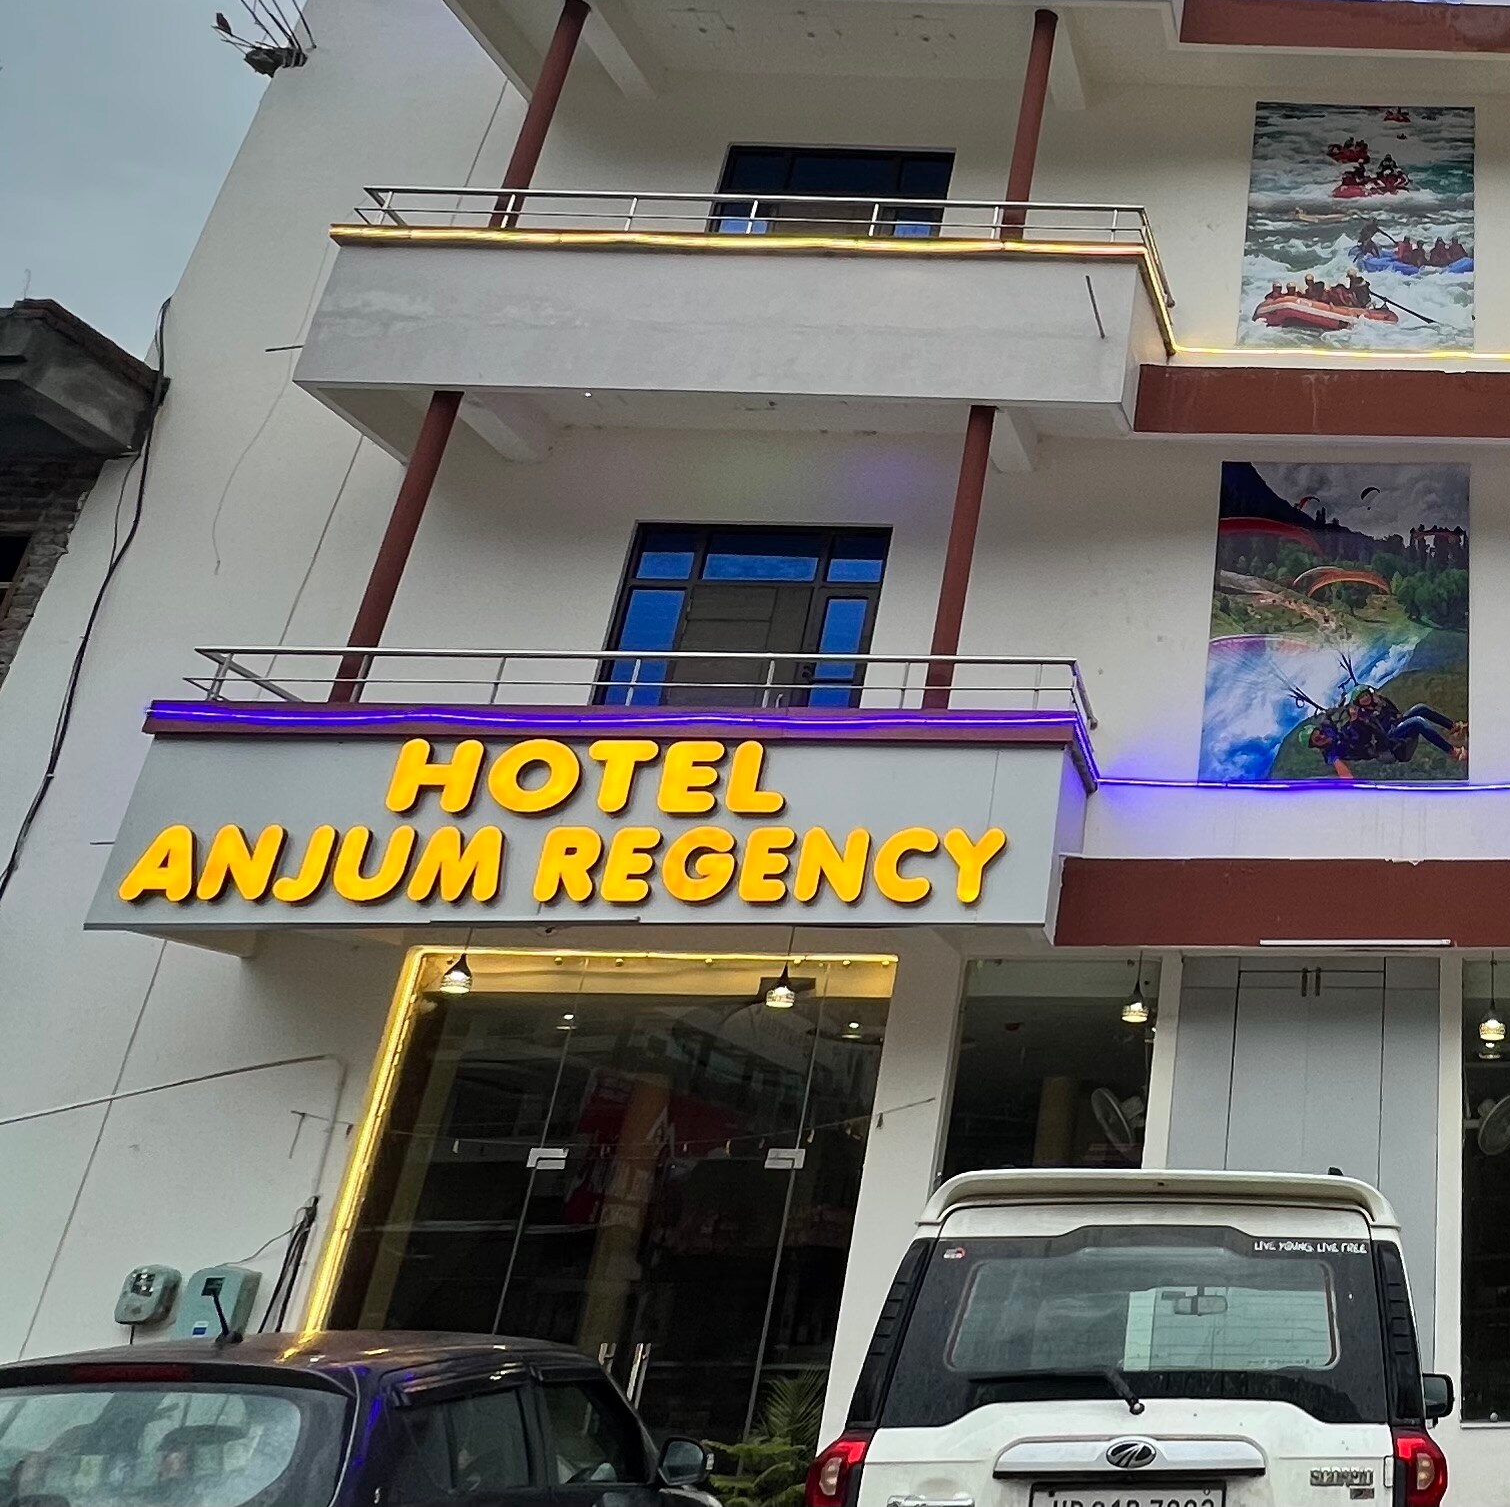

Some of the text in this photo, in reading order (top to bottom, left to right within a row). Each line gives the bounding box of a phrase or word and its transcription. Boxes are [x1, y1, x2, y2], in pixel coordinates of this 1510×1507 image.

[385, 739, 785, 815] HOTEL
[116, 824, 1008, 904] ANJUM REGENCY
[1254, 1240, 1276, 1251] LIVE
[1317, 1242, 1339, 1253] LIVE
[1341, 1242, 1367, 1254] FREE
